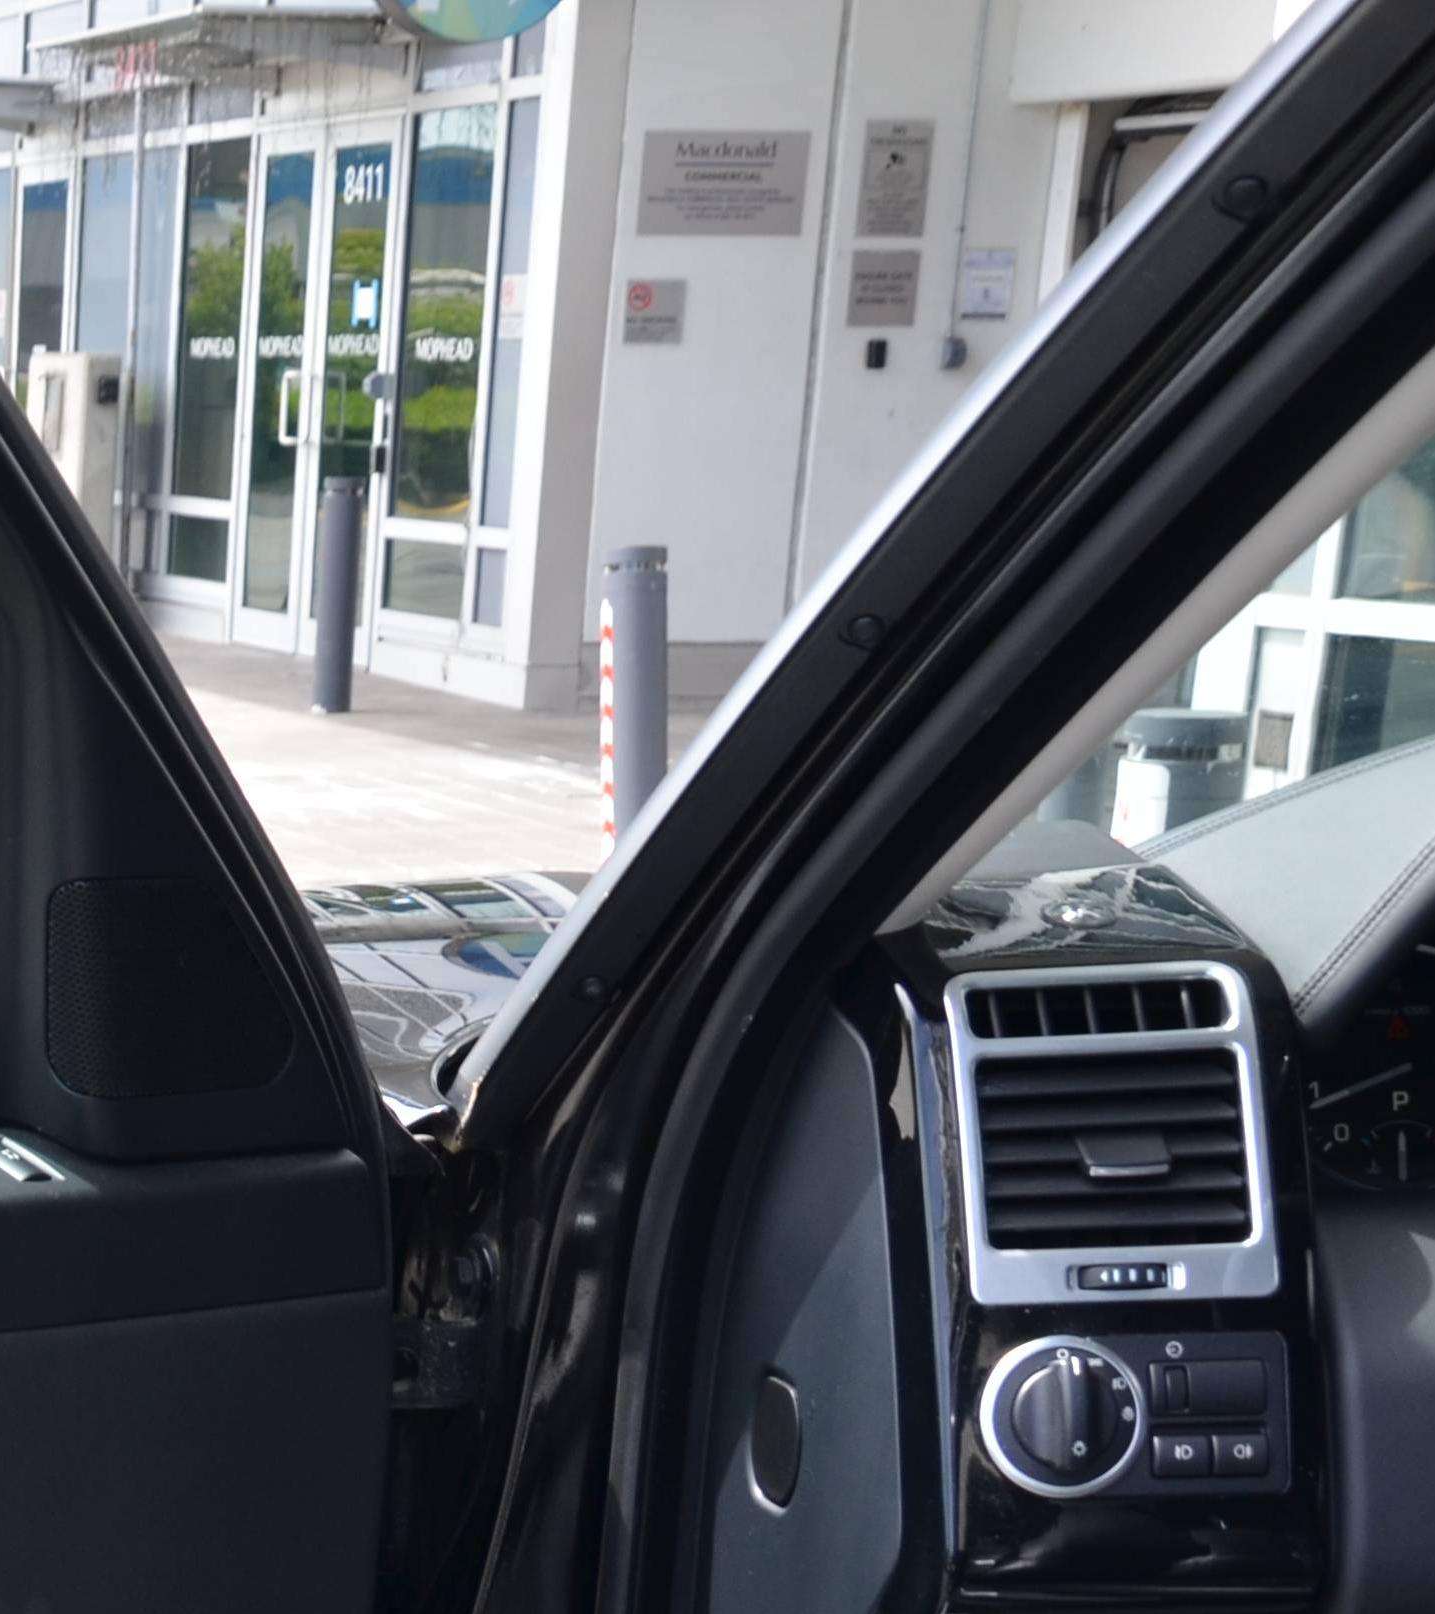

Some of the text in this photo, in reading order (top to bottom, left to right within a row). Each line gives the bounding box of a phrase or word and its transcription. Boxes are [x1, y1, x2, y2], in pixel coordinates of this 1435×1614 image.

[675, 139, 779, 160] Macdonald
[344, 164, 385, 205] 8411
[1392, 1090, 1410, 1112] P
